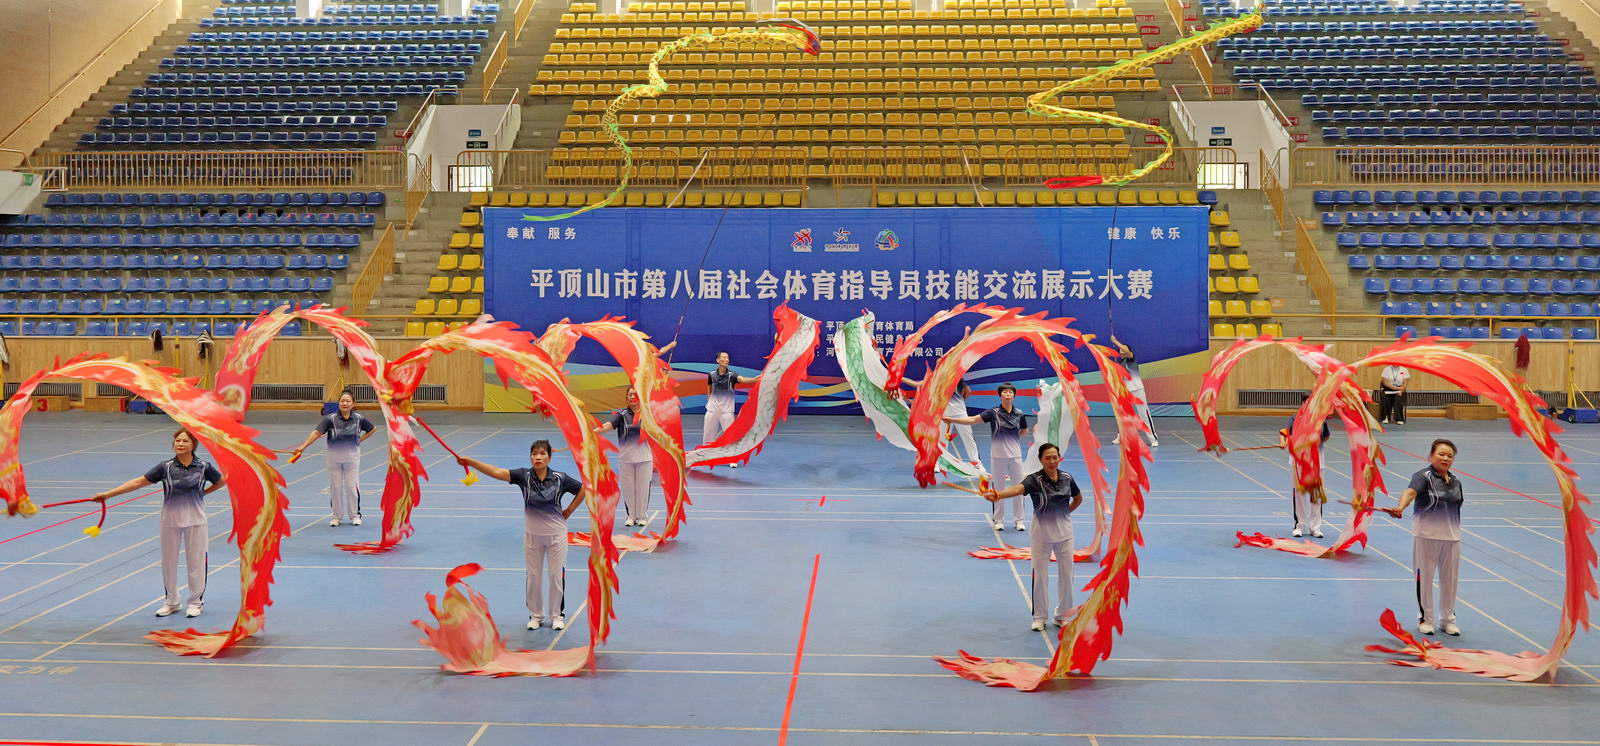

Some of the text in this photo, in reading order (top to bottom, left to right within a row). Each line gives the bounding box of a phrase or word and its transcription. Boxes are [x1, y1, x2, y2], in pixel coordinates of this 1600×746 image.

[507, 227, 577, 240] 奉献 服务
[1107, 227, 1181, 240] 健康 快乐
[530, 268, 1154, 301] 平顶山市第八届社会体育指导员技能交流展示大赛
[37, 398, 48, 412] 3
